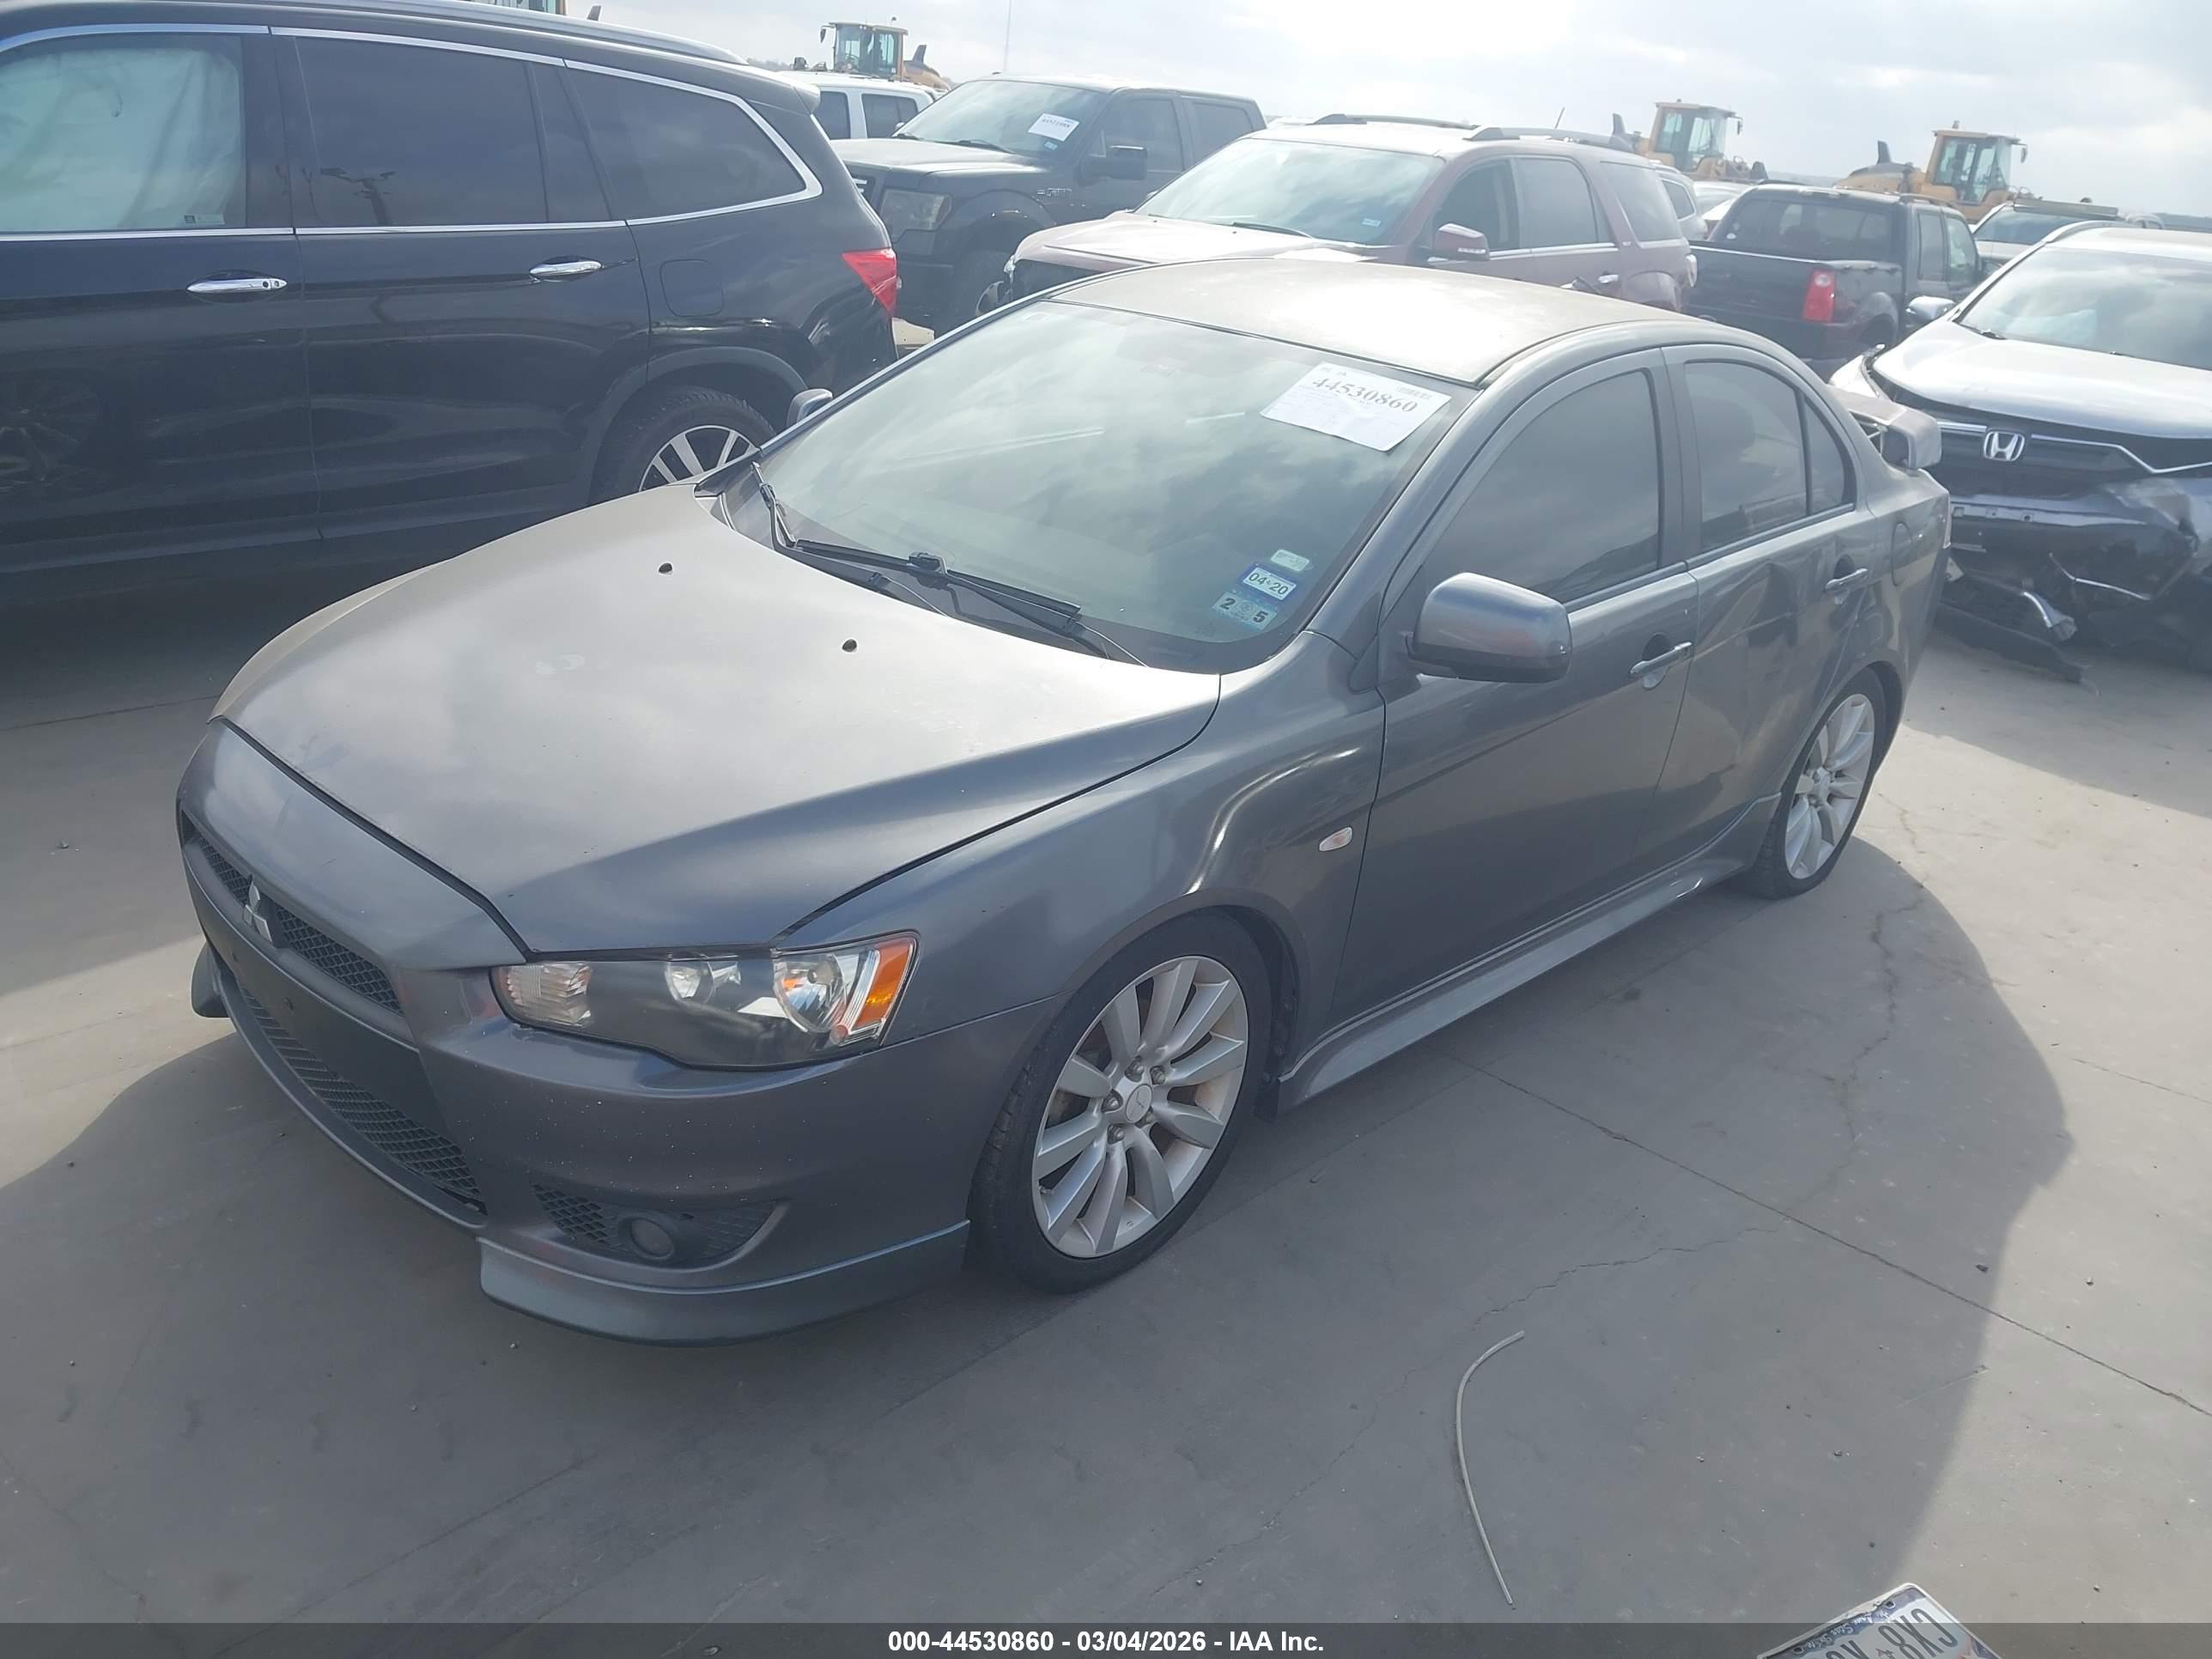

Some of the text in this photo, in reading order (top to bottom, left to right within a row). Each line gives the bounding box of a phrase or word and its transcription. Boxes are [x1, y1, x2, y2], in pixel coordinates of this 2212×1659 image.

[1312, 377, 1419, 412] 44530860
[1220, 598, 1269, 623] 2 5
